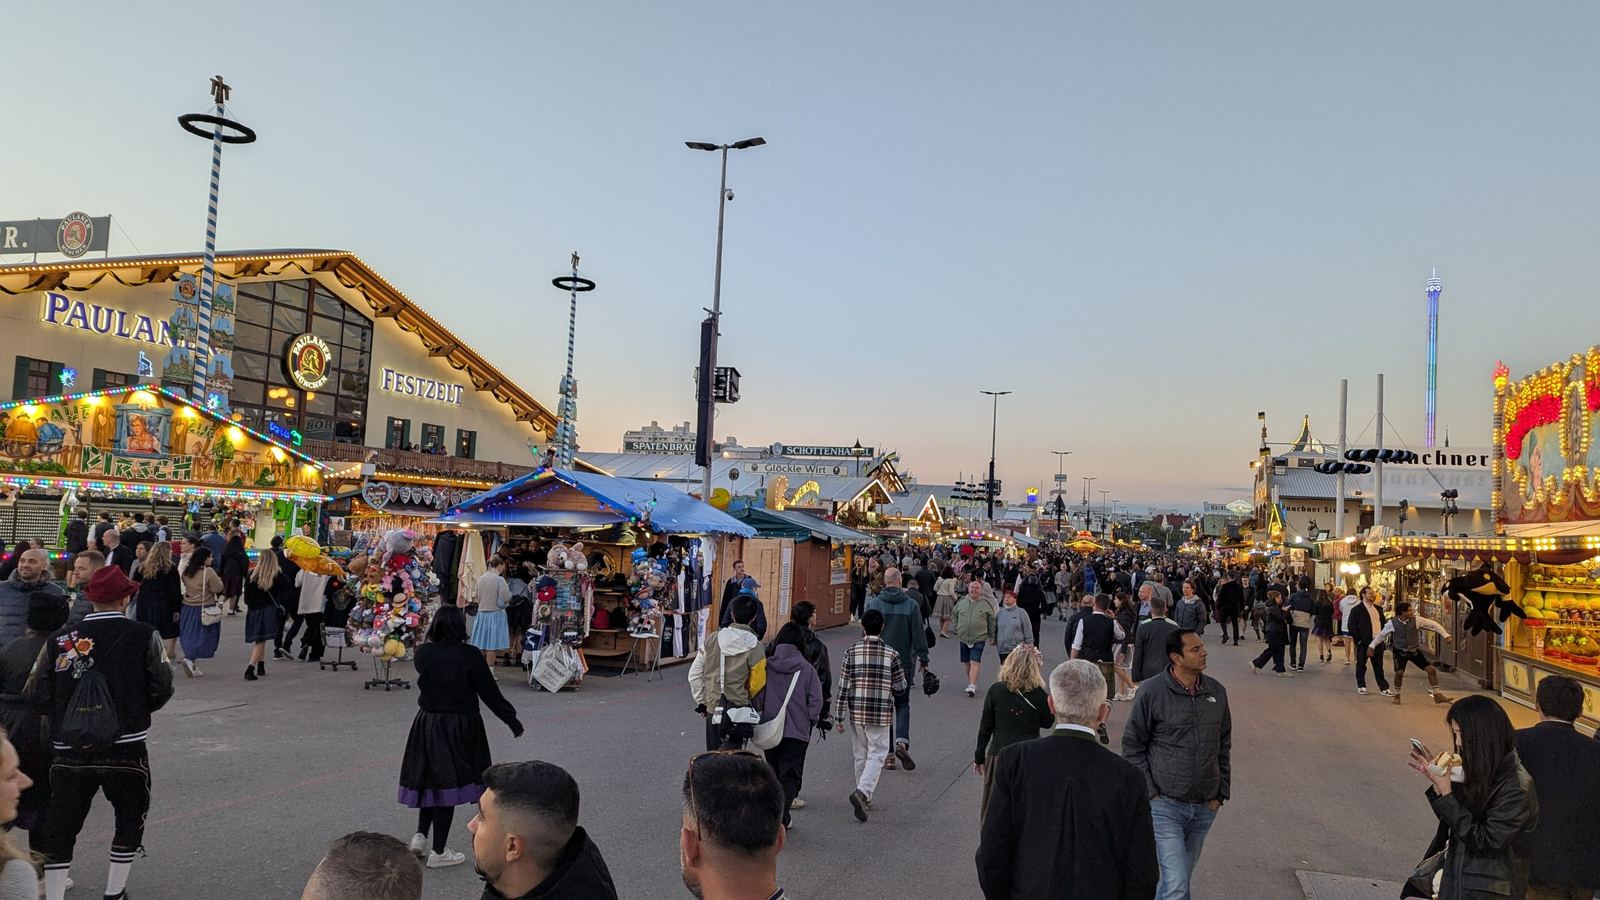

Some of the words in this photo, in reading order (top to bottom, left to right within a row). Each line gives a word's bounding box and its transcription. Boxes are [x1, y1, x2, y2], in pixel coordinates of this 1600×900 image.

[61, 213, 91, 231] PAULANER
[0, 226, 28, 248] R.
[41, 290, 218, 357] PAULAN
[293, 335, 332, 362] PAULANER
[293, 369, 328, 389] MÜNCHEN
[380, 367, 465, 405] FESTZELT
[80, 443, 193, 481] PIRSCH
[764, 463, 802, 473] Glöckle
[805, 464, 827, 474] Wirt
